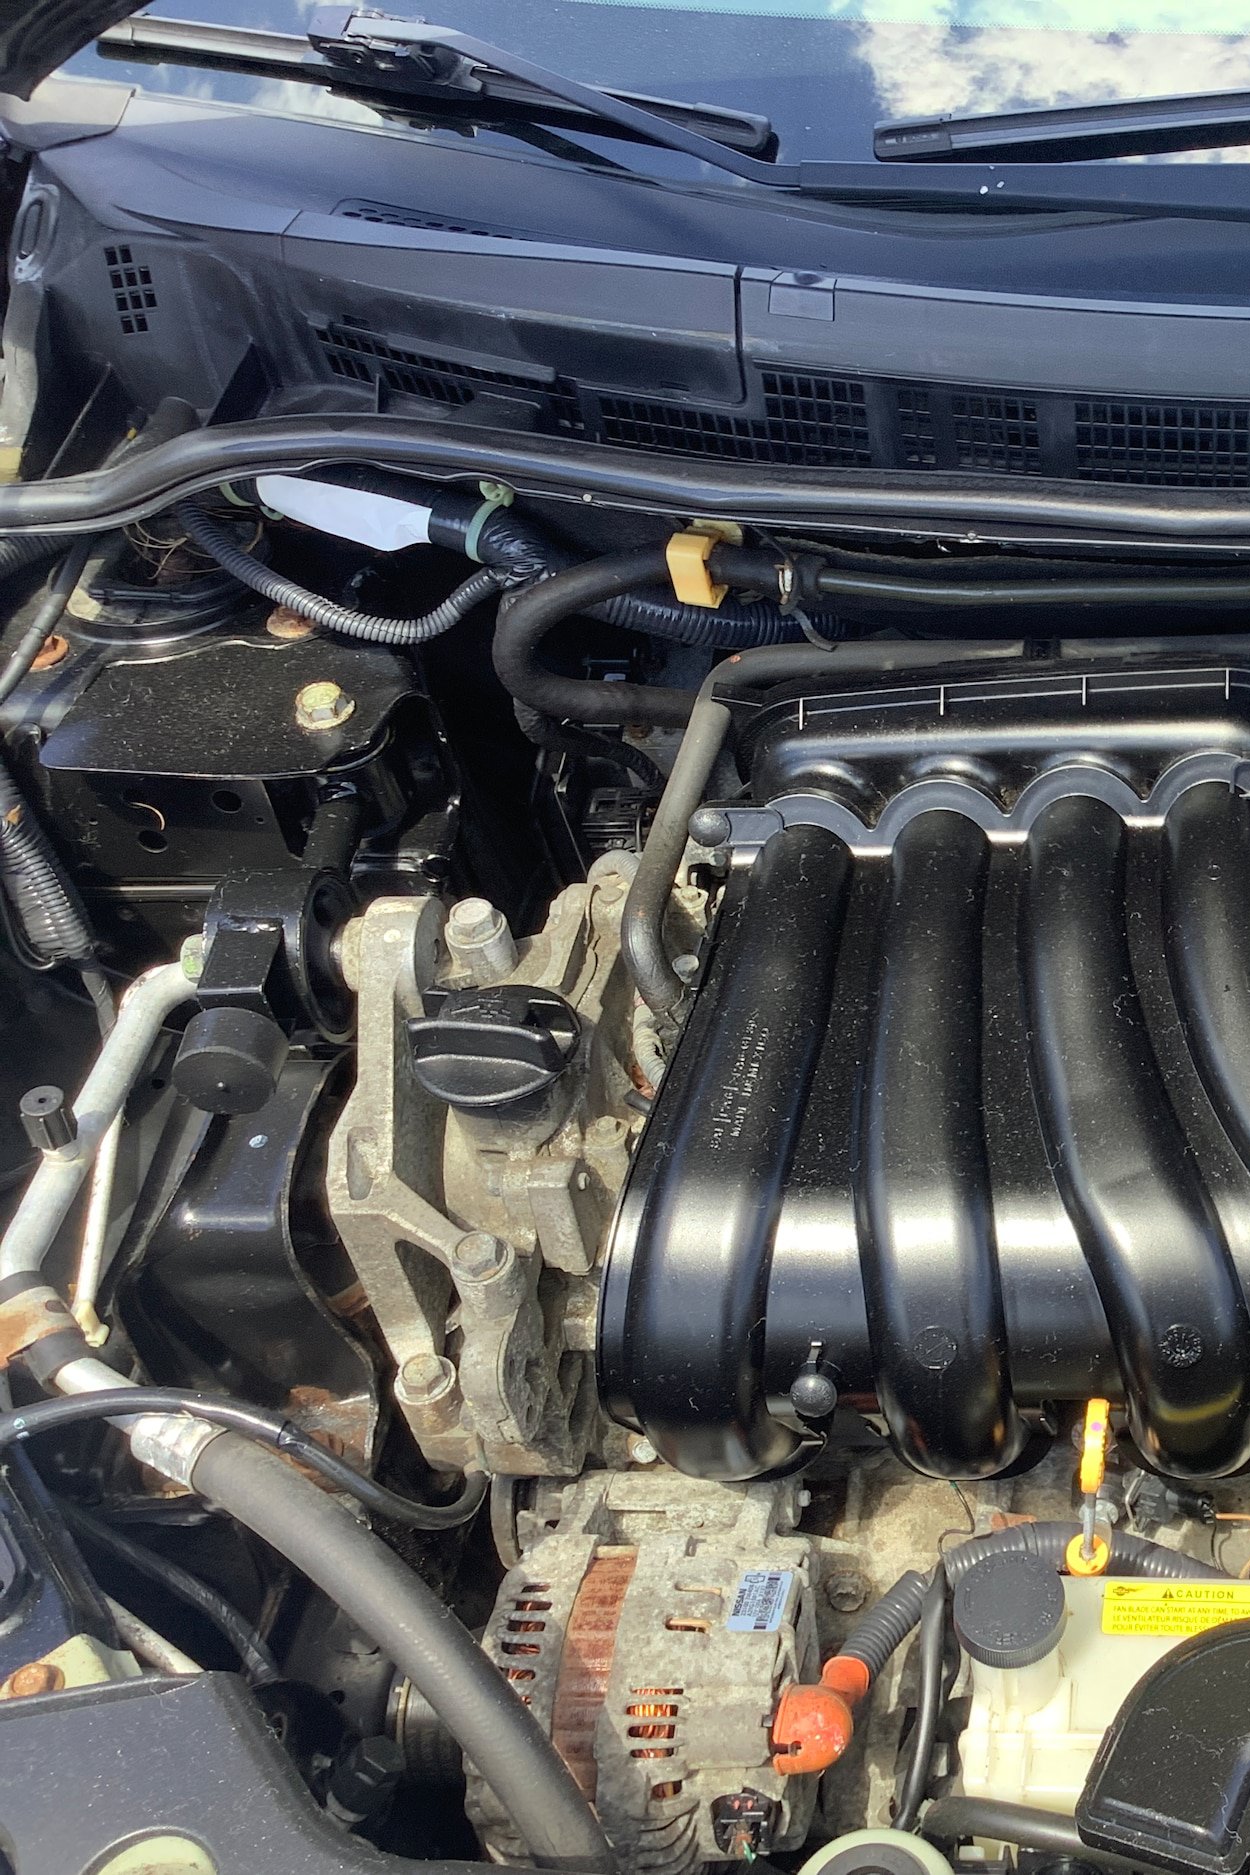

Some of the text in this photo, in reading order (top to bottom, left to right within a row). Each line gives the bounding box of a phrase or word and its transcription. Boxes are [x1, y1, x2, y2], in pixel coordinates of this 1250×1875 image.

[1176, 1589, 1235, 1600] CAUTION
[732, 1588, 747, 1617] NISSAN
[1128, 1605, 1149, 1613] BLADE
[1167, 1606, 1186, 1614] START
[1122, 1615, 1171, 1623] VENTILATEUR
[1173, 1616, 1199, 1625] RISQUE
